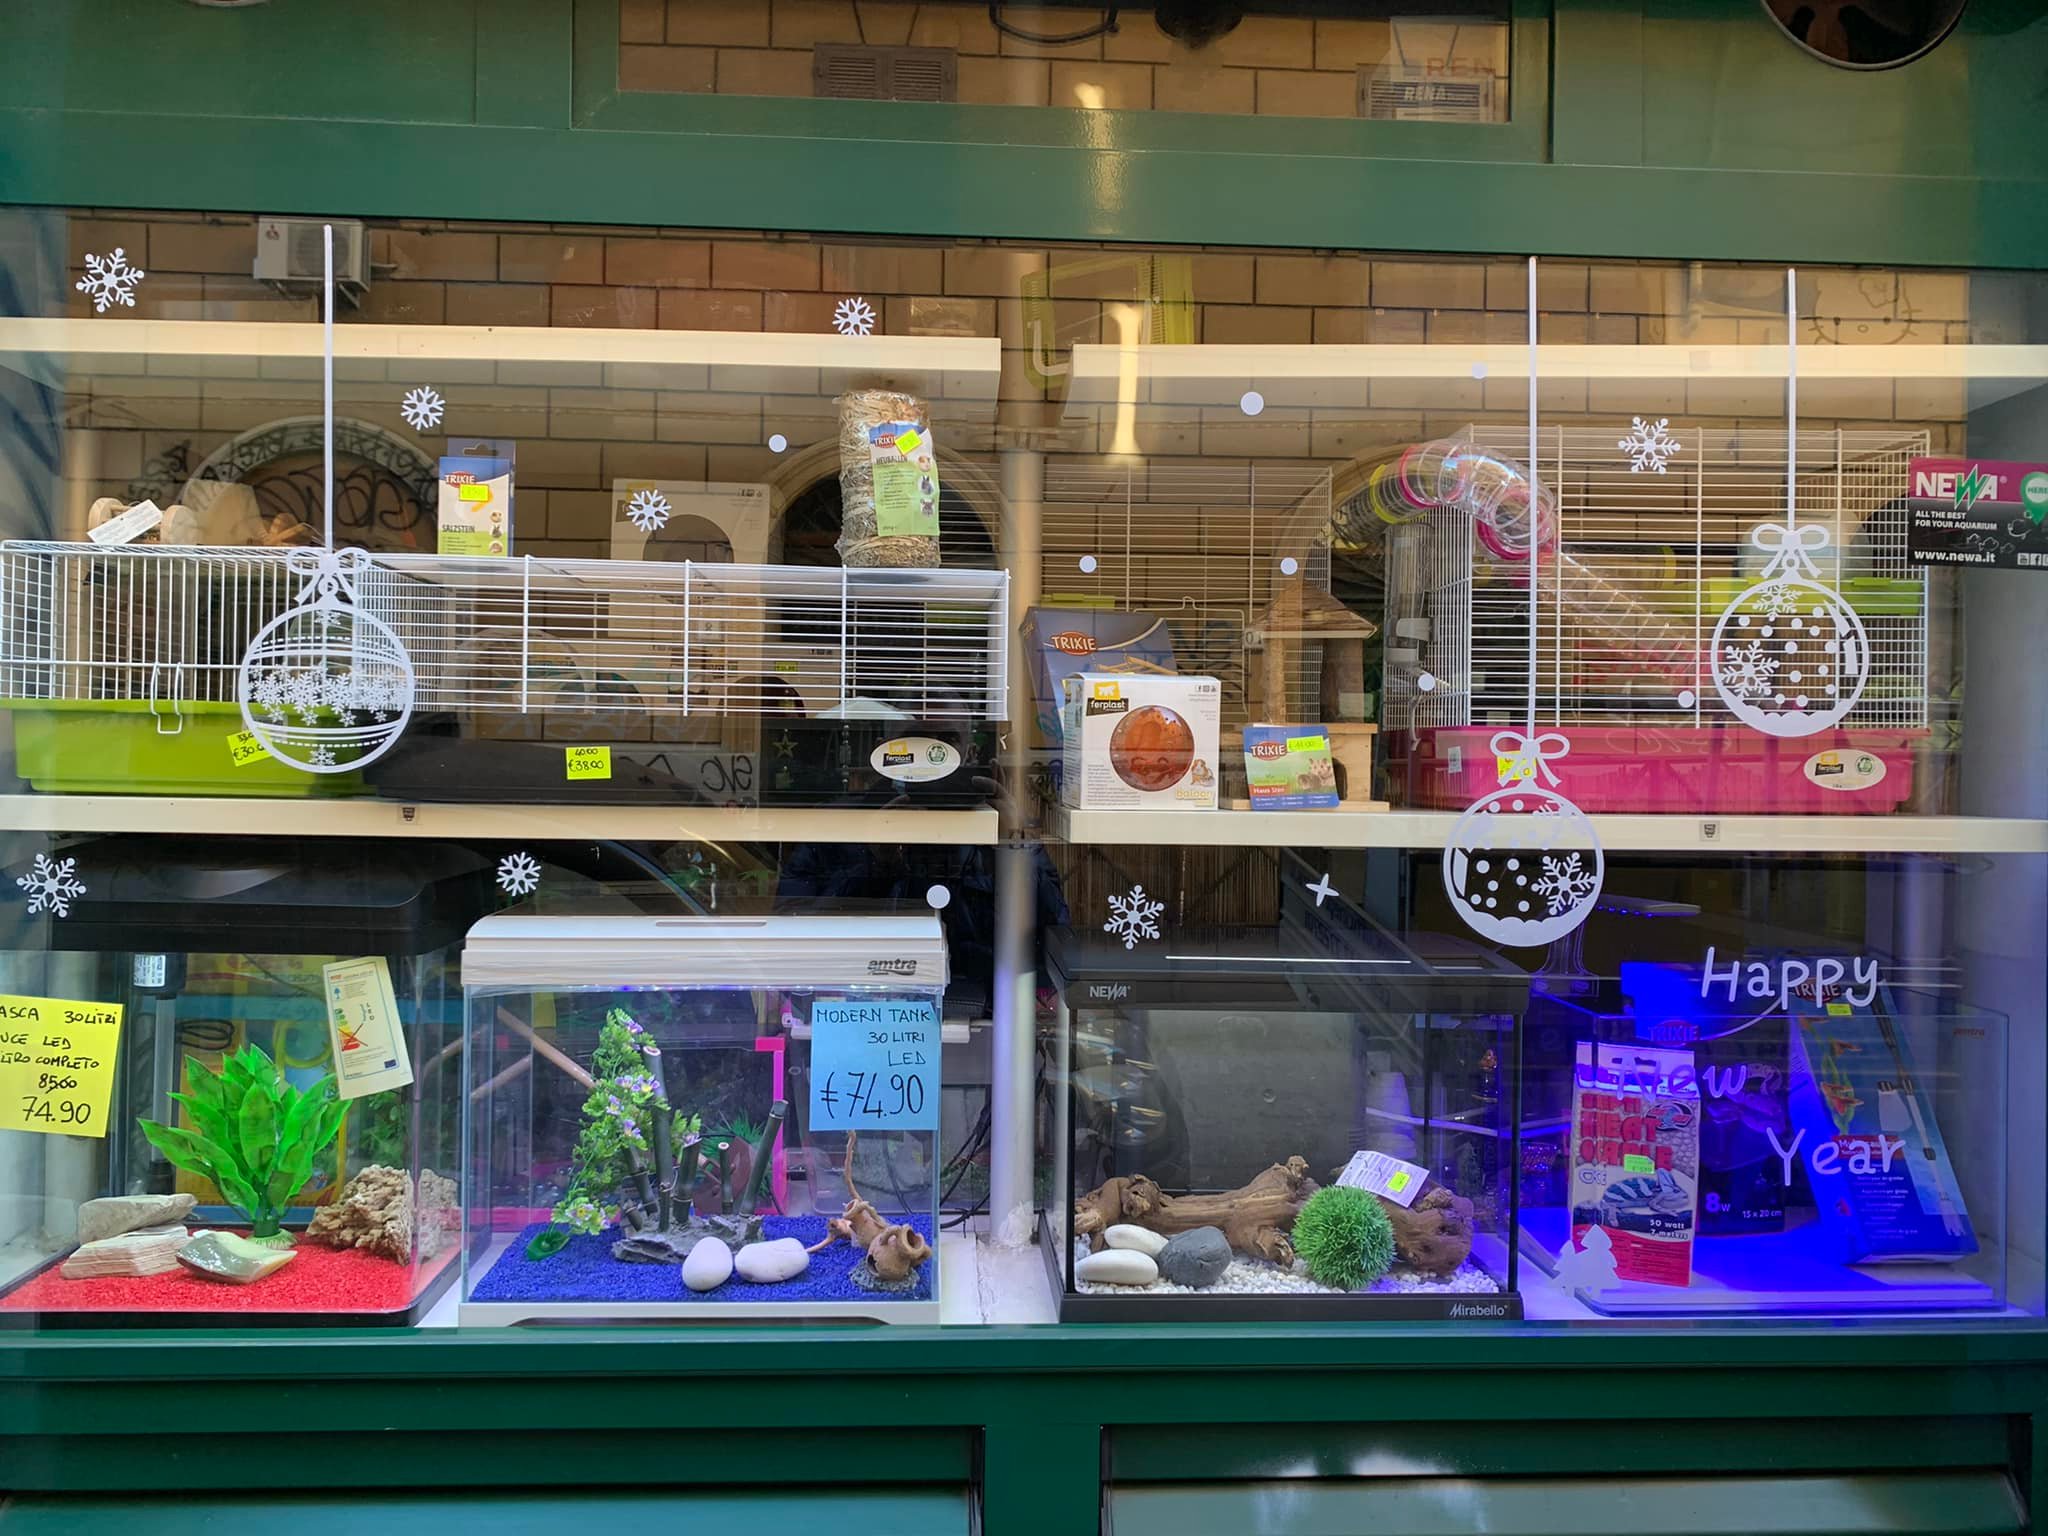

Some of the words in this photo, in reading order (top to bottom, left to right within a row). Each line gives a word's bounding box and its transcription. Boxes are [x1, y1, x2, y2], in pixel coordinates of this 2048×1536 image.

[873, 436, 896, 450] TRIXI
[445, 474, 477, 485] TRIXIE
[1915, 510, 1931, 518] ALL
[1931, 511, 1947, 519] THE
[1915, 519, 1931, 527] FOR
[1932, 520, 1954, 528] YOUR
[1954, 521, 1998, 531] AQUARIUM
[1914, 550, 1996, 563] www.newa.it
[1051, 636, 1097, 651] TRIXIE
[1090, 700, 1127, 712] ferplast
[1250, 744, 1287, 757] TRIXIE
[867, 958, 918, 971] amtra
[1702, 947, 1878, 1011] Happy
[1089, 981, 1128, 1001] NEWA
[1793, 982, 1840, 997] TRIIE
[816, 1008, 882, 1024] MODERN
[888, 1008, 931, 1023] TANK
[43, 1036, 71, 1050] LED
[867, 1031, 888, 1044] 30
[892, 1031, 925, 1043] LITRI
[35, 1055, 100, 1069] COMPLETO
[888, 1050, 927, 1067] LED
[1614, 1053, 1747, 1101] New
[819, 1071, 924, 1119] €74.90
[22, 1096, 92, 1125] 74.90
[1581, 1111, 1662, 1142] HEAT
[1766, 1127, 1906, 1187] Year
[1742, 1210, 1752, 1218] 15
[1759, 1209, 1769, 1218] 20
[1664, 1221, 1685, 1230] watt
[1449, 1302, 1505, 1318] Mirabello
